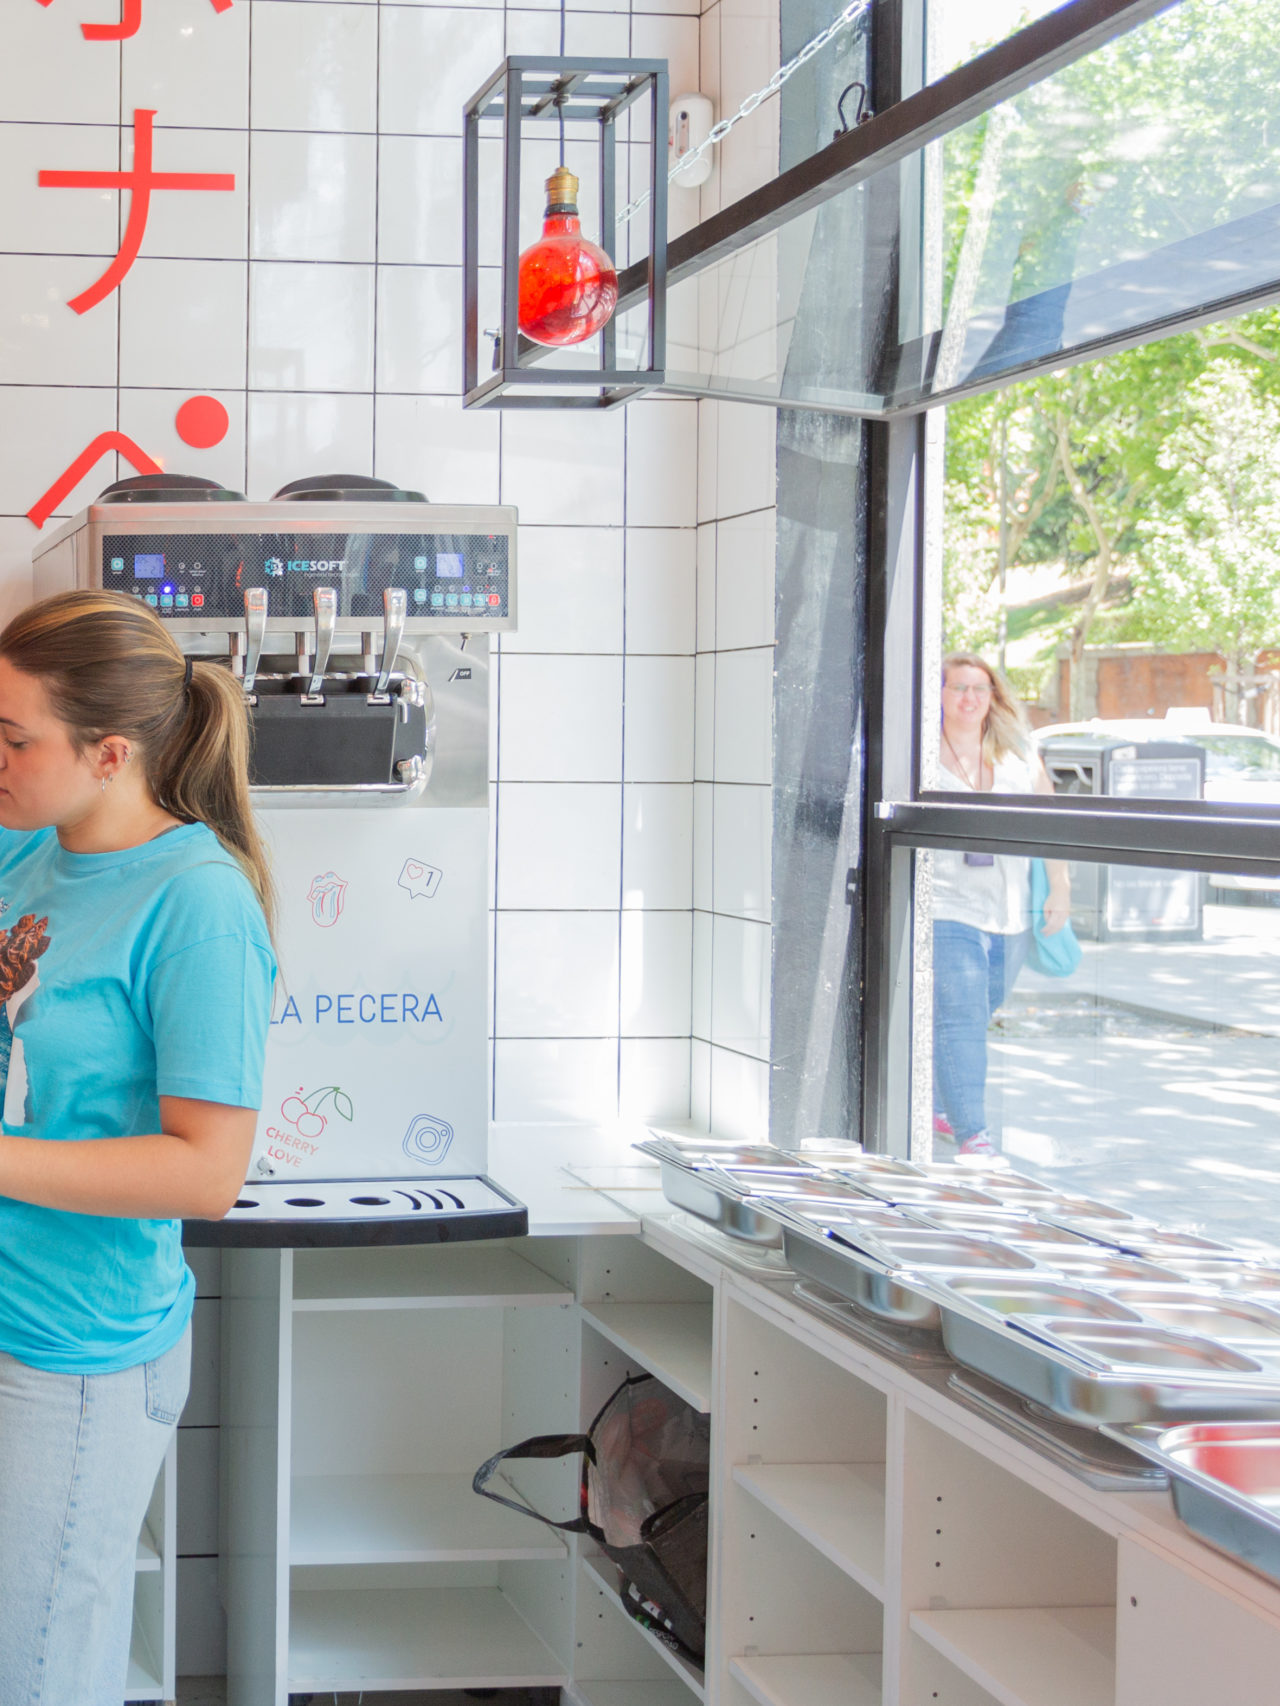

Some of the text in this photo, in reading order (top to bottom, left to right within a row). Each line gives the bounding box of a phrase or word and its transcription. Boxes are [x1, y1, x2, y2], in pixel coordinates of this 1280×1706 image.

[27, 0, 235, 529] ナペ
[287, 560, 346, 572] ICESOFT
[316, 993, 443, 1024] PECERA
[265, 1126, 320, 1156] CHERRY
[267, 1145, 302, 1168] LOVE
